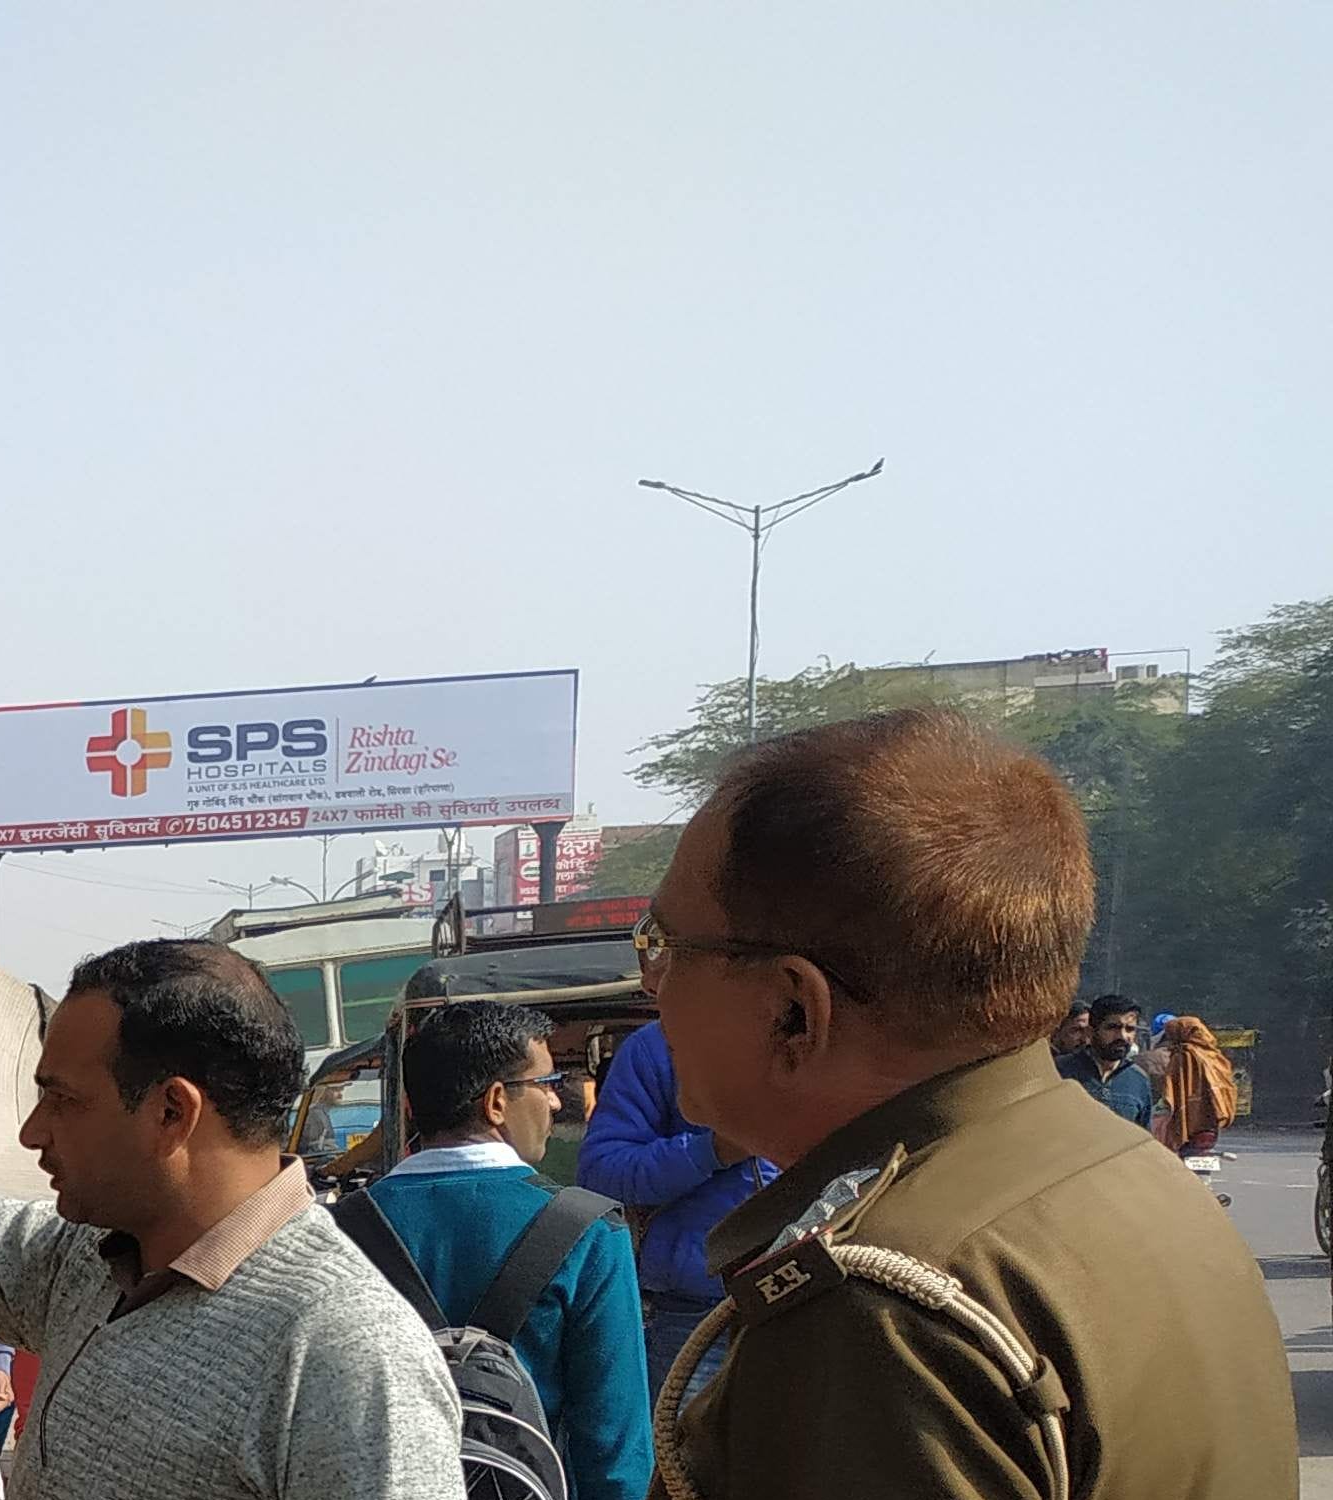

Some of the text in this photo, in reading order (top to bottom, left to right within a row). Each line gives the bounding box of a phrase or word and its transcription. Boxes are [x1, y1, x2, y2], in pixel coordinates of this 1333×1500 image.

[187, 719, 328, 763] SPS
[349, 724, 415, 749] Rishta
[187, 759, 327, 780] HOSPITALS
[345, 747, 457, 776] Zindagi Se
[187, 785, 194, 794] A
[195, 784, 215, 793] UNIT
[218, 783, 230, 792] OF
[250, 778, 306, 790] HEALTHCARE
[312, 809, 348, 824] 24X7
[411, 800, 432, 818] की
[19, 823, 89, 844] इमरजेंसी
[185, 810, 301, 833] 7504512345
